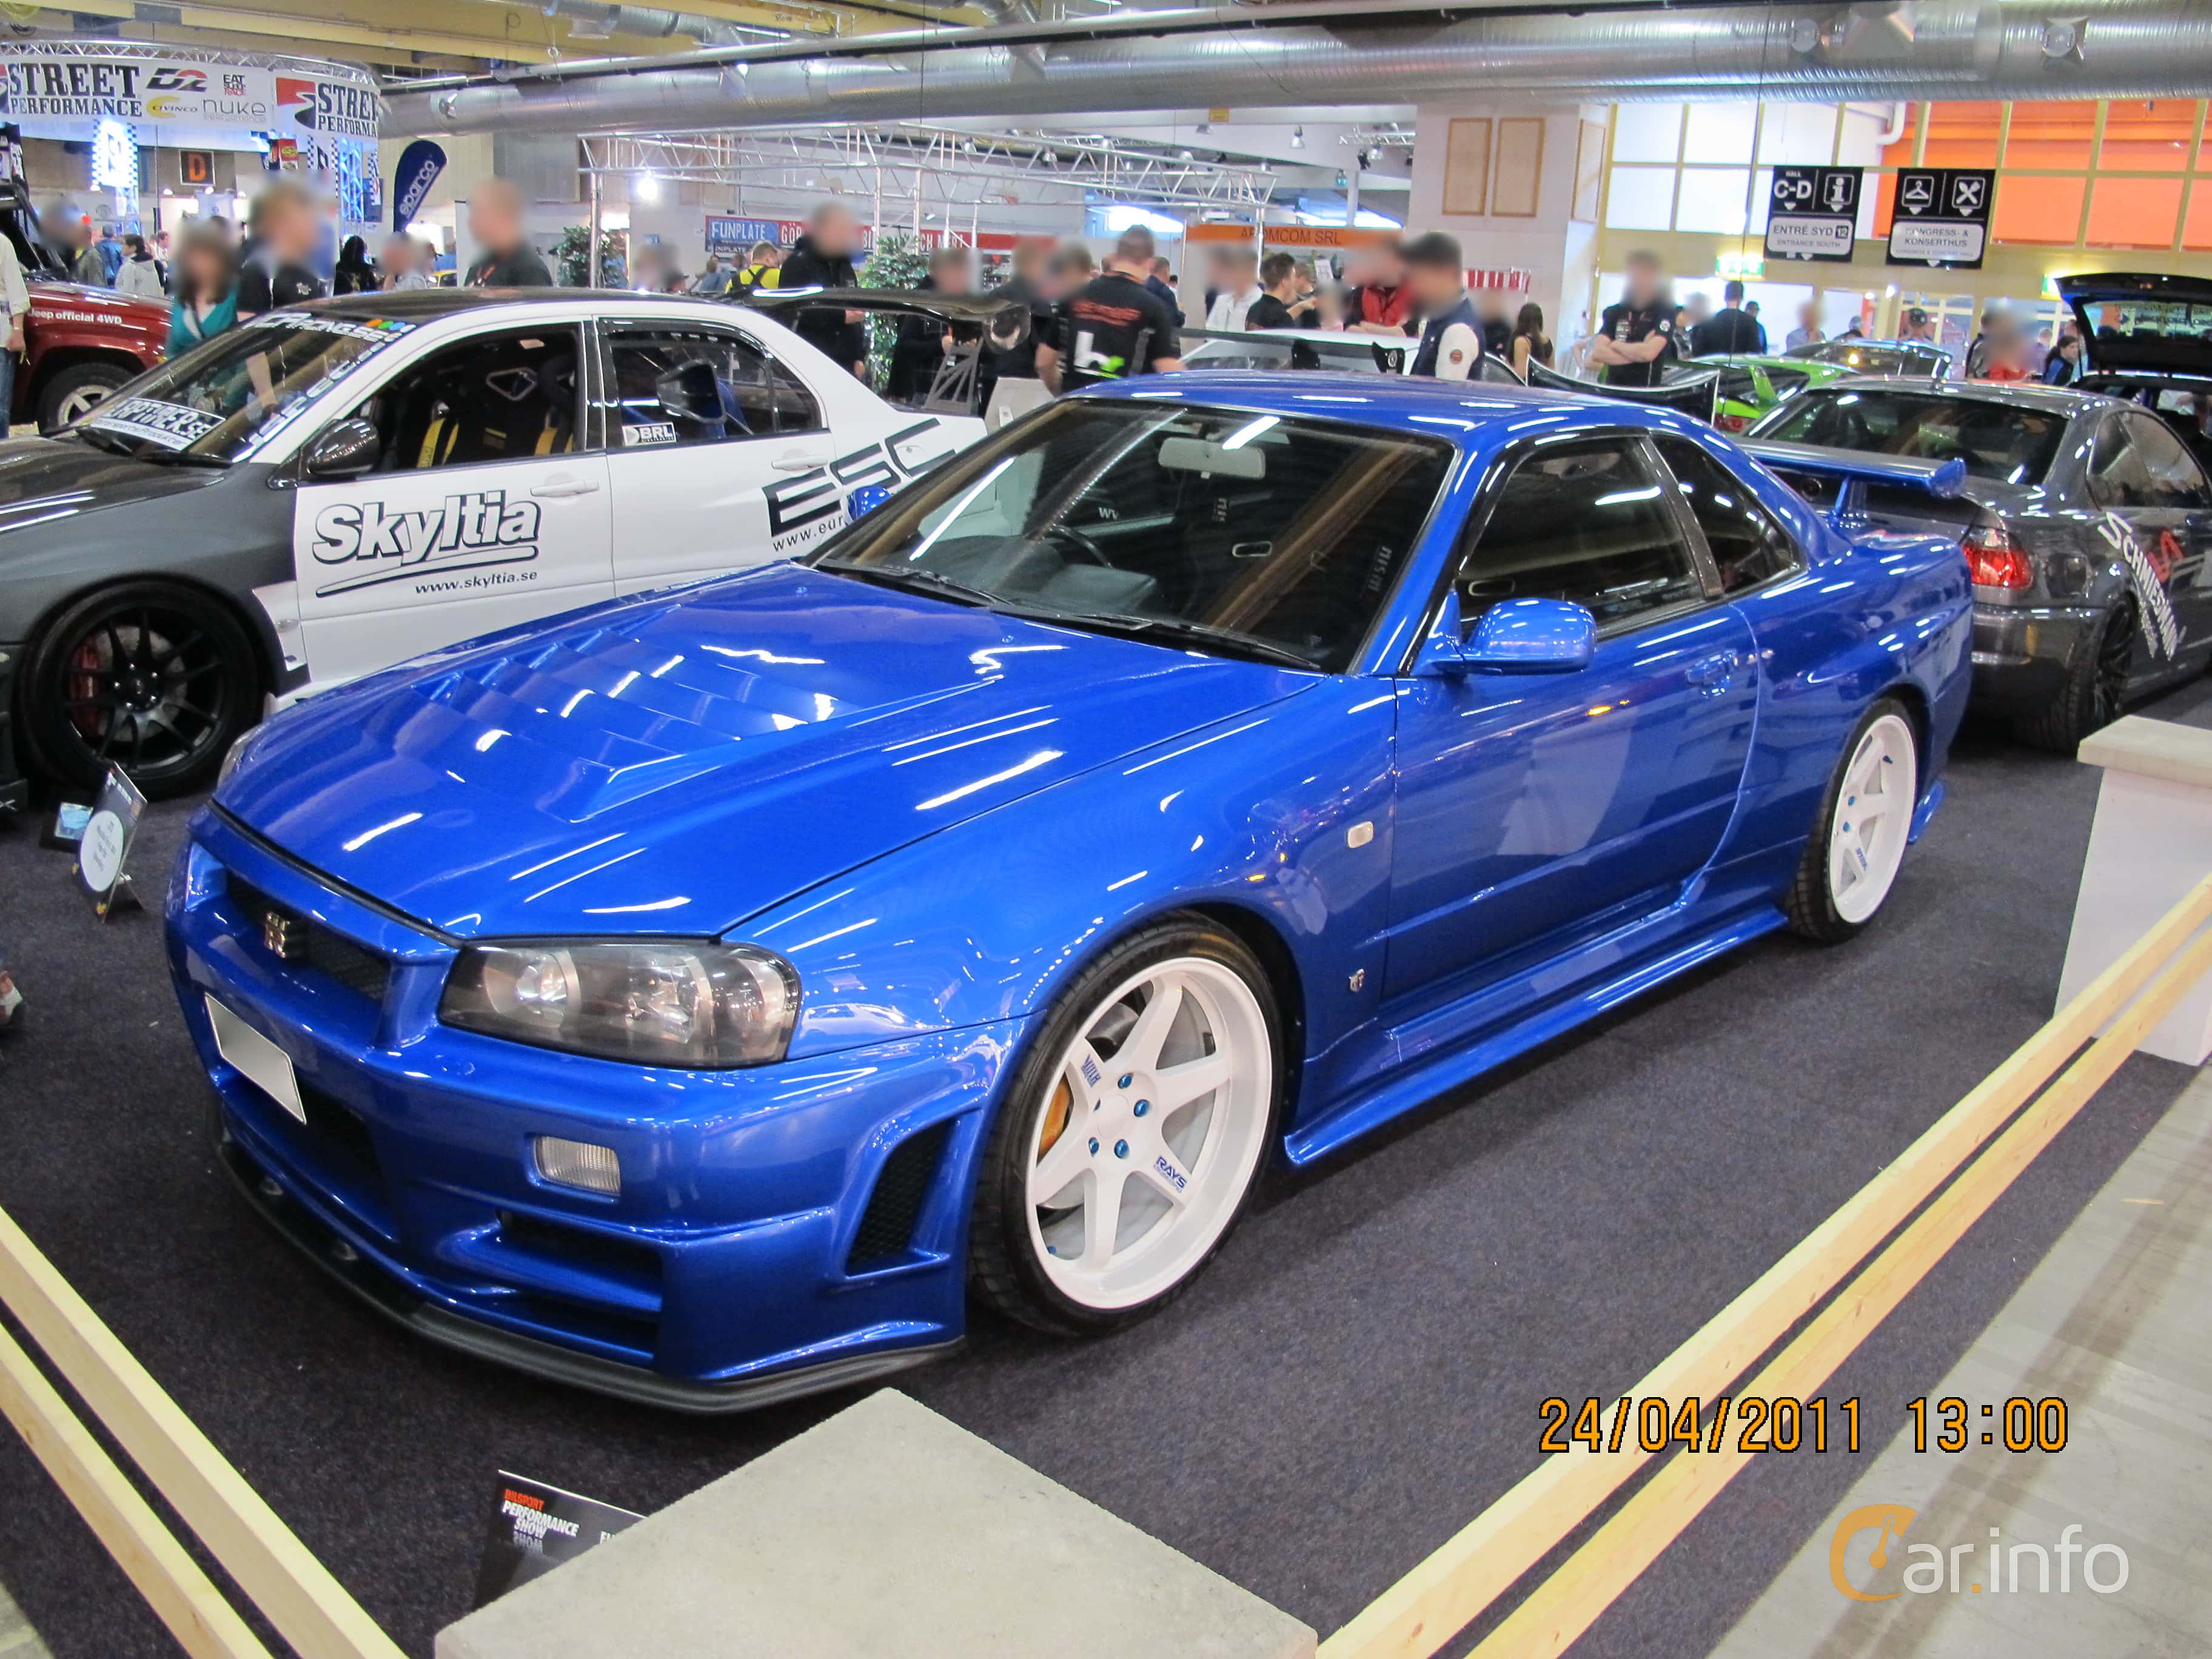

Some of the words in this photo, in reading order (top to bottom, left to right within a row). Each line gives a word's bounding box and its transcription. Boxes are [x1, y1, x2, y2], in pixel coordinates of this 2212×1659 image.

[8, 63, 140, 98] STREET
[223, 75, 245, 83] EAT
[10, 98, 142, 117] PERFORMANCE
[203, 99, 266, 116] nuke
[189, 153, 207, 181] D
[400, 160, 435, 215] sparco
[1774, 180, 1812, 199] C-D
[711, 221, 766, 241] FUNPLATE
[1314, 230, 1342, 245] SRL
[1811, 226, 1833, 236] SYD
[1905, 238, 1968, 247] KONSERTHUS
[55, 311, 94, 323] official
[96, 314, 122, 325] 4WD
[312, 489, 541, 567] Skyltia
[415, 571, 538, 595] www.skyltia.se
[1156, 1155, 1187, 1188] RAYS
[502, 1498, 580, 1538] PERFORMANCE
[514, 1517, 547, 1539] SHOW
